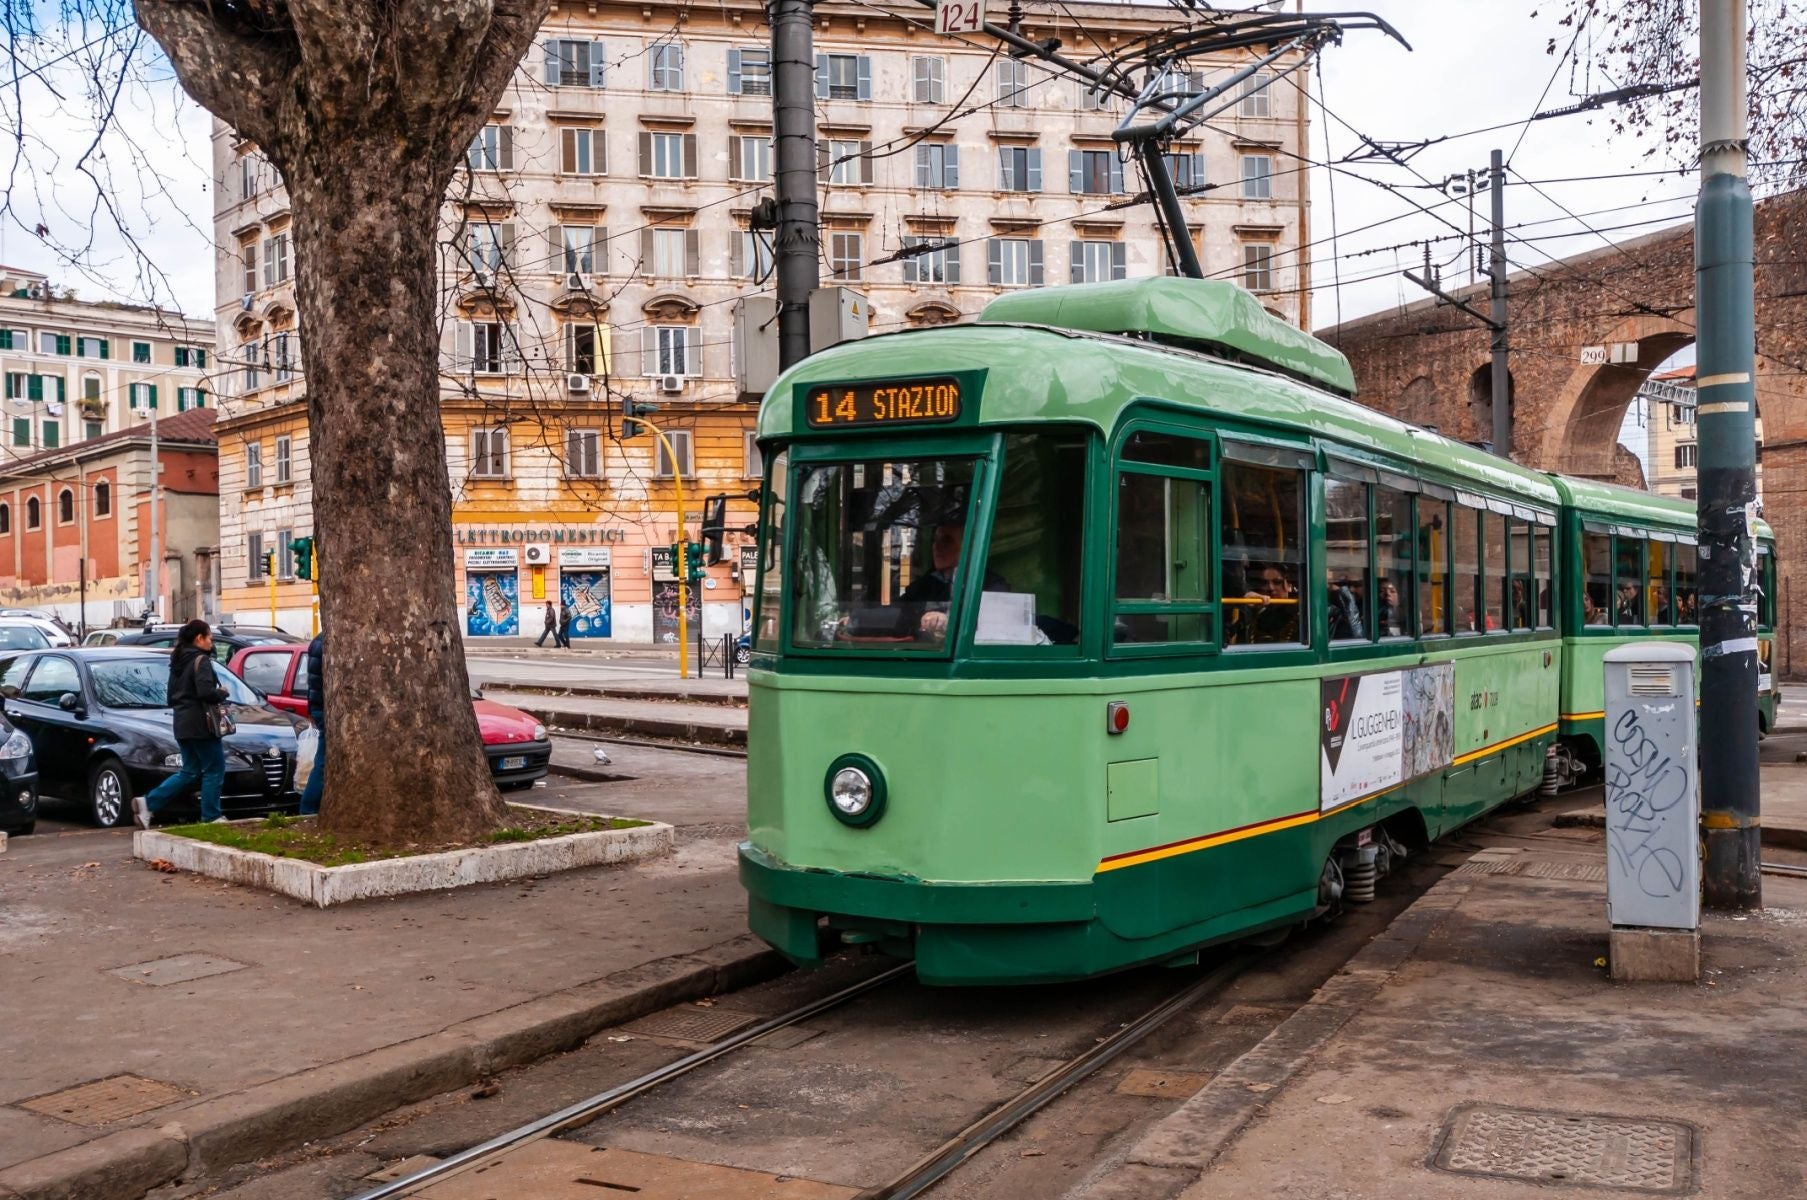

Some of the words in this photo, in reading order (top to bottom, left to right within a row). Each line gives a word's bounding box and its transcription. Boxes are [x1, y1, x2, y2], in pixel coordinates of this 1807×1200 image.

[941, 2, 978, 32] 124
[1582, 350, 1605, 364] 299
[816, 391, 857, 422] 14
